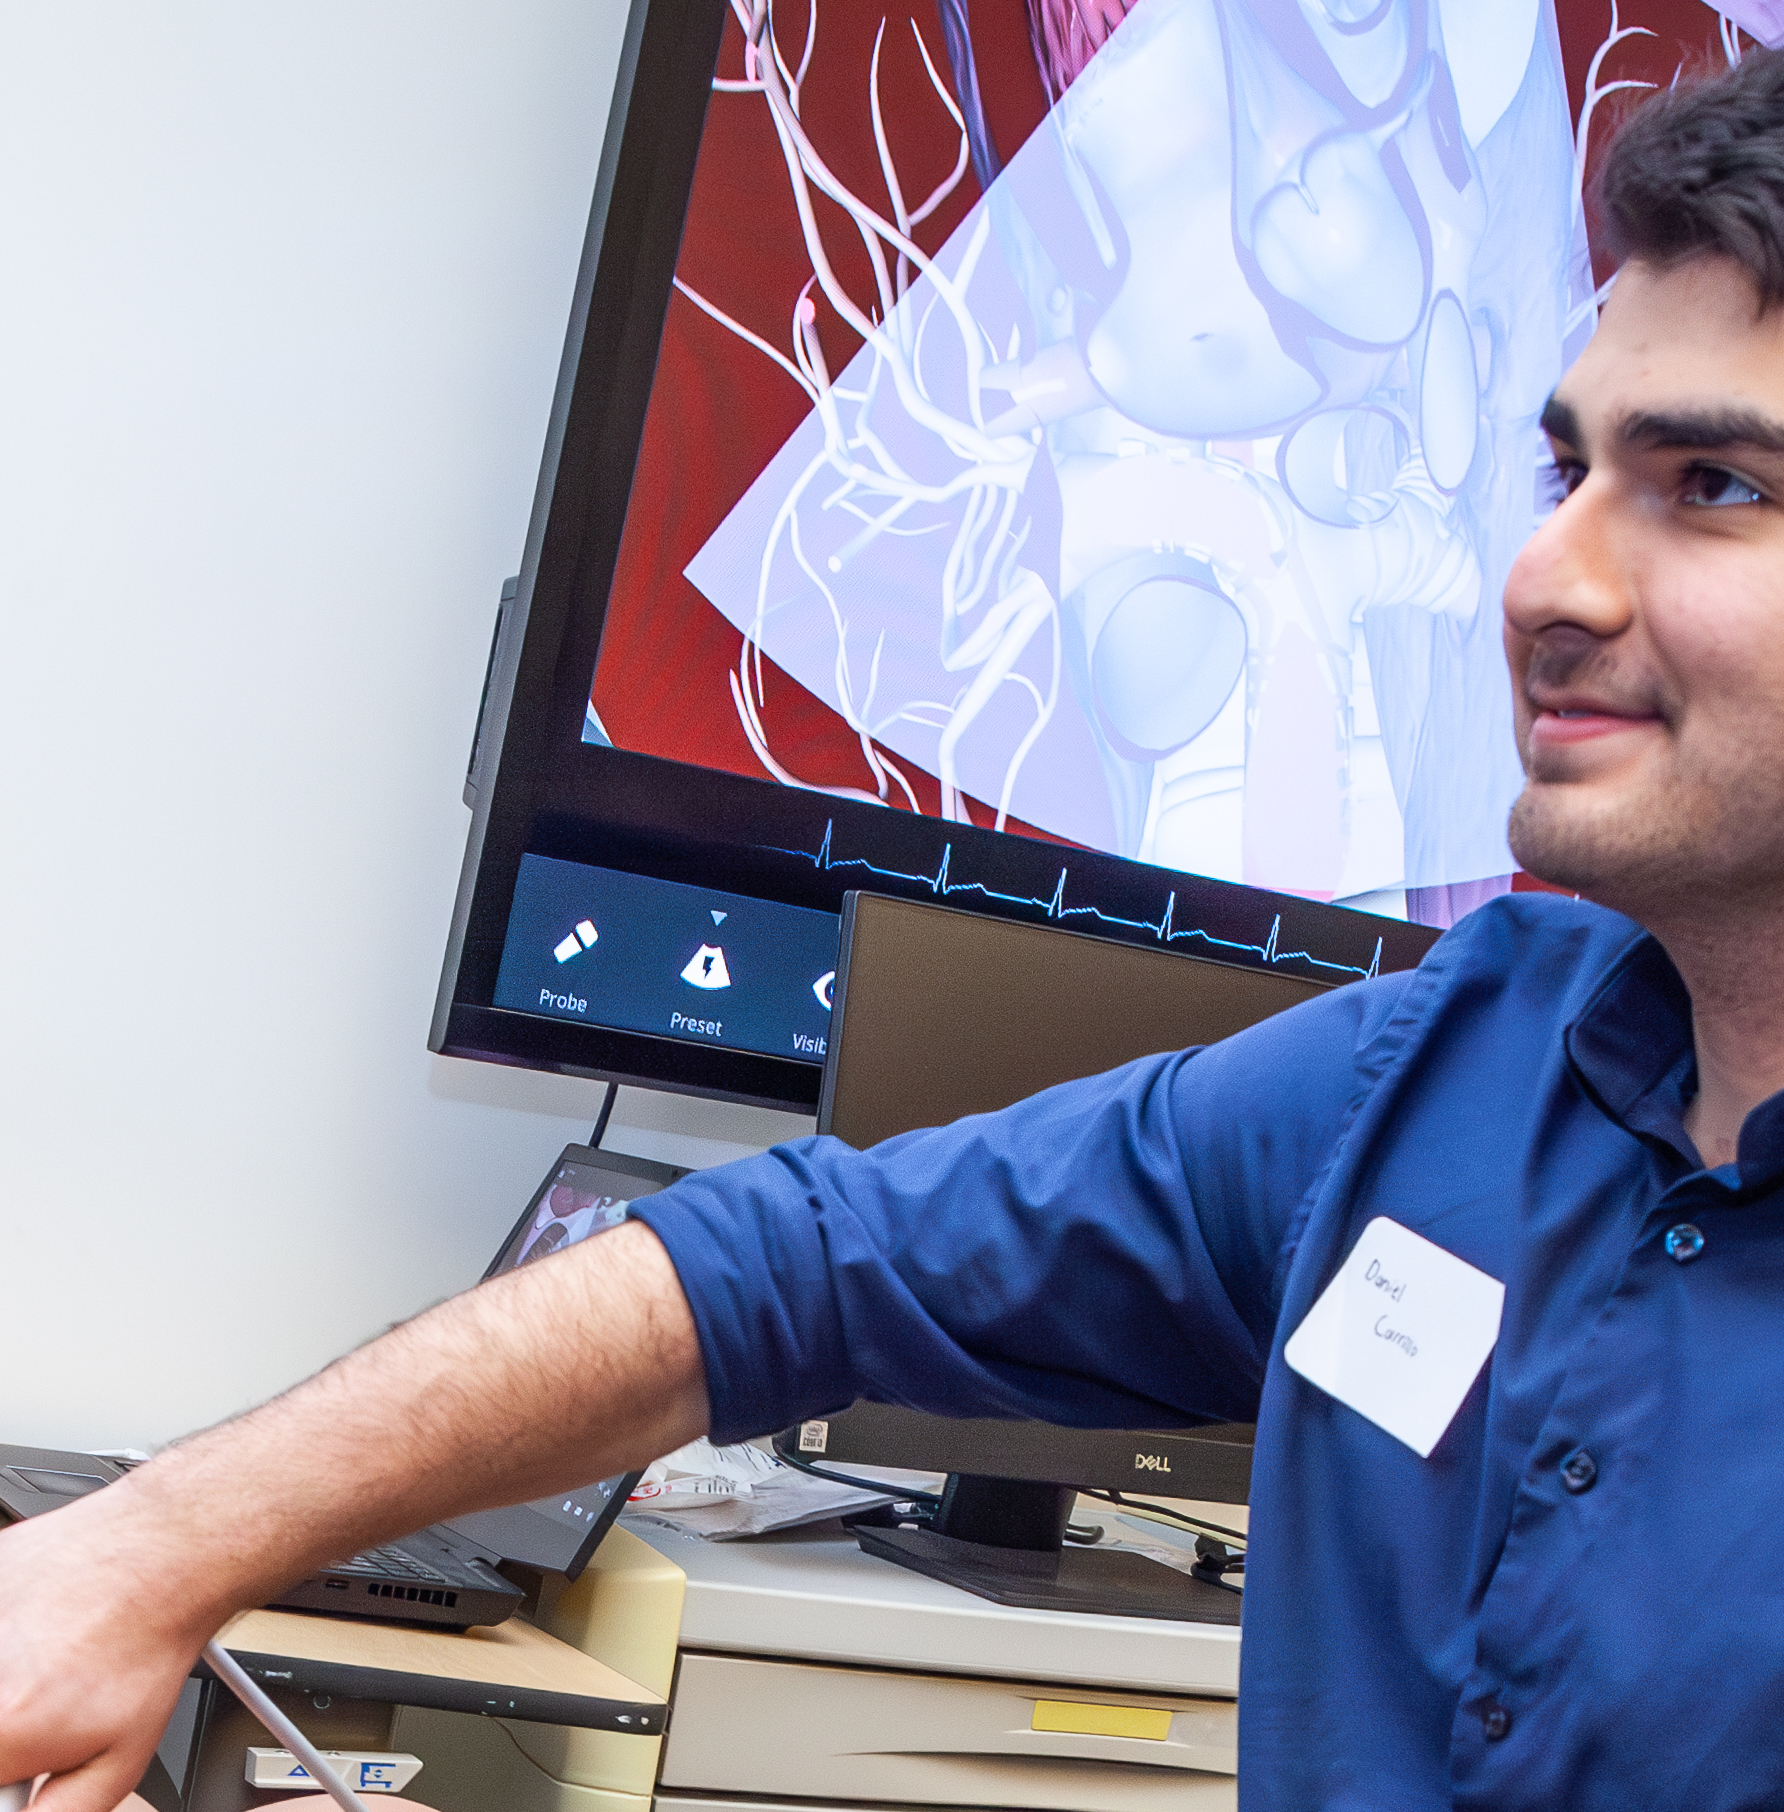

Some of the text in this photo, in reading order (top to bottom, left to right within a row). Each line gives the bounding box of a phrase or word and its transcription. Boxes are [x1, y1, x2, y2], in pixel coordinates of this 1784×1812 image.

[539, 988, 588, 1013] Probe
[670, 1011, 723, 1038] Preset
[793, 1033, 828, 1055] Visib
[1136, 1454, 1172, 1473] DELL
